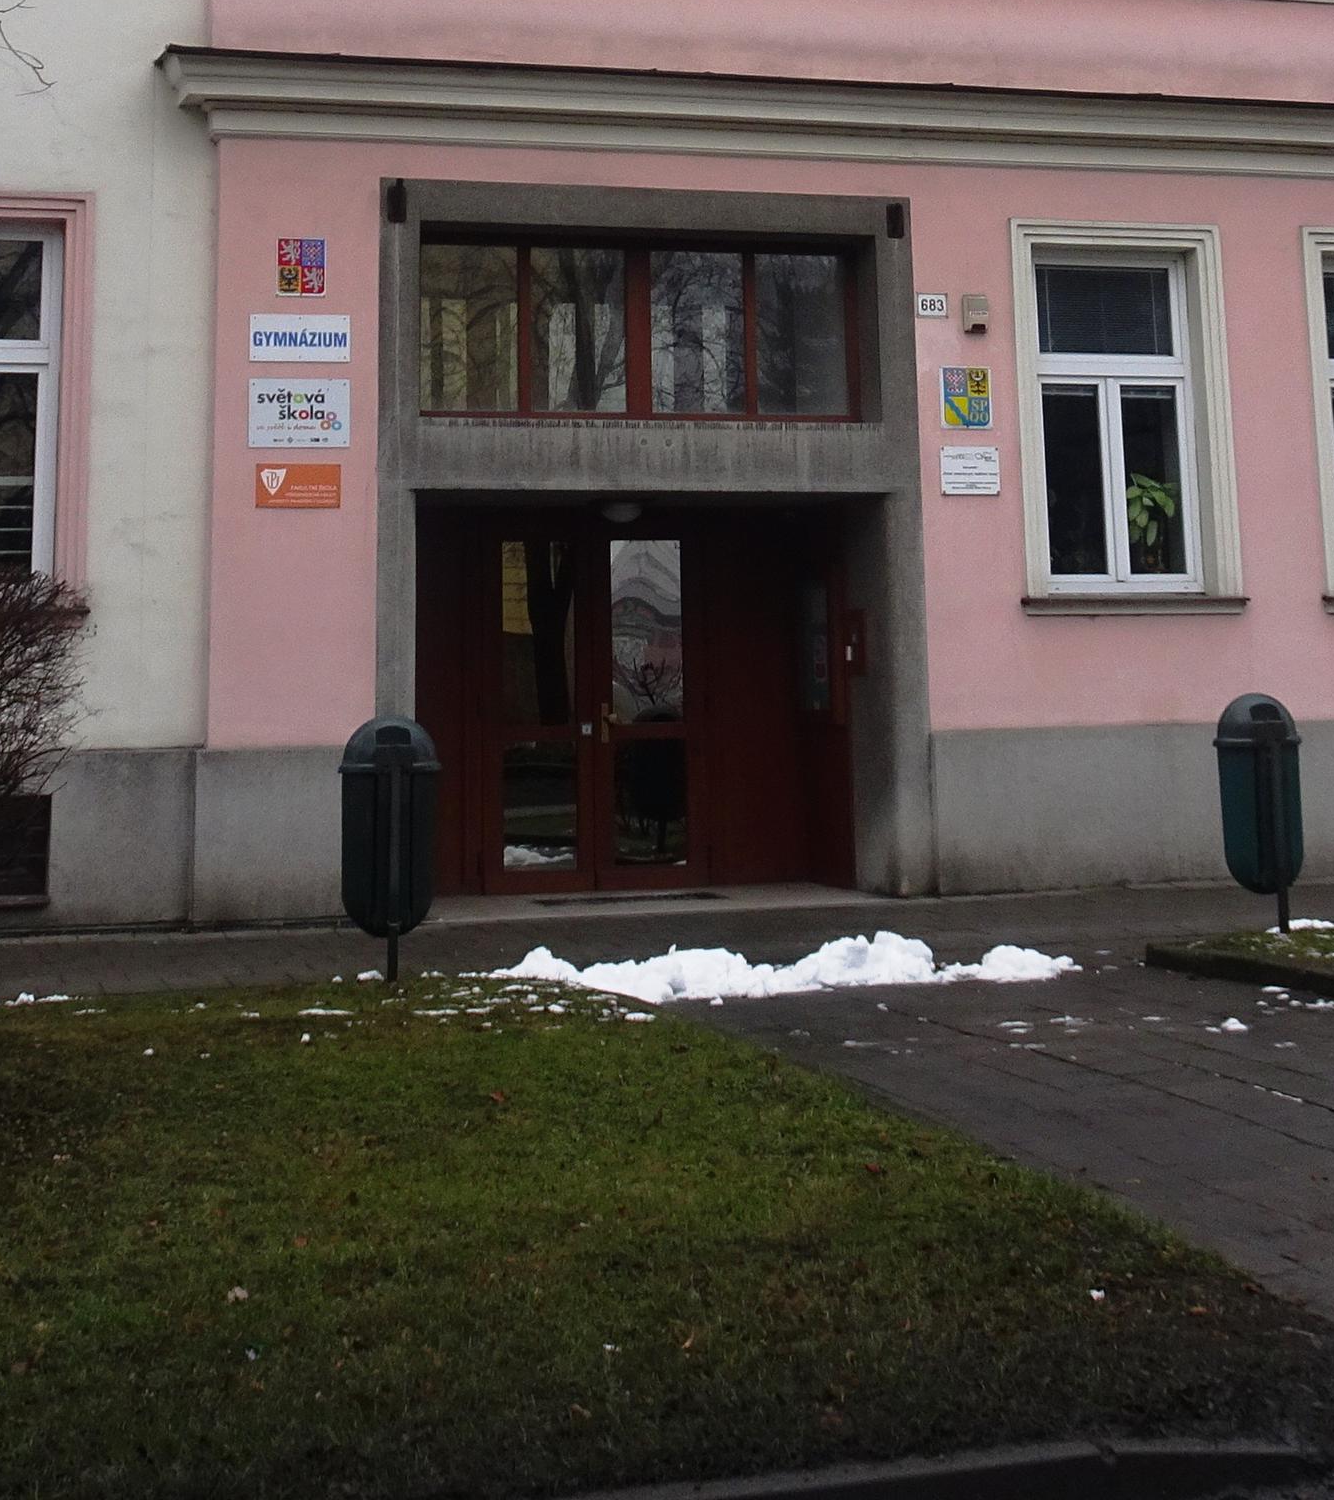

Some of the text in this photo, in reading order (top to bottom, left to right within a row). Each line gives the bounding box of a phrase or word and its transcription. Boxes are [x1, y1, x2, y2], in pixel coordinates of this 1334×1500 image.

[921, 298, 944, 311] 683
[252, 328, 347, 348] GYMNÁZIUM
[257, 388, 325, 404] světová
[278, 404, 325, 420] škola
